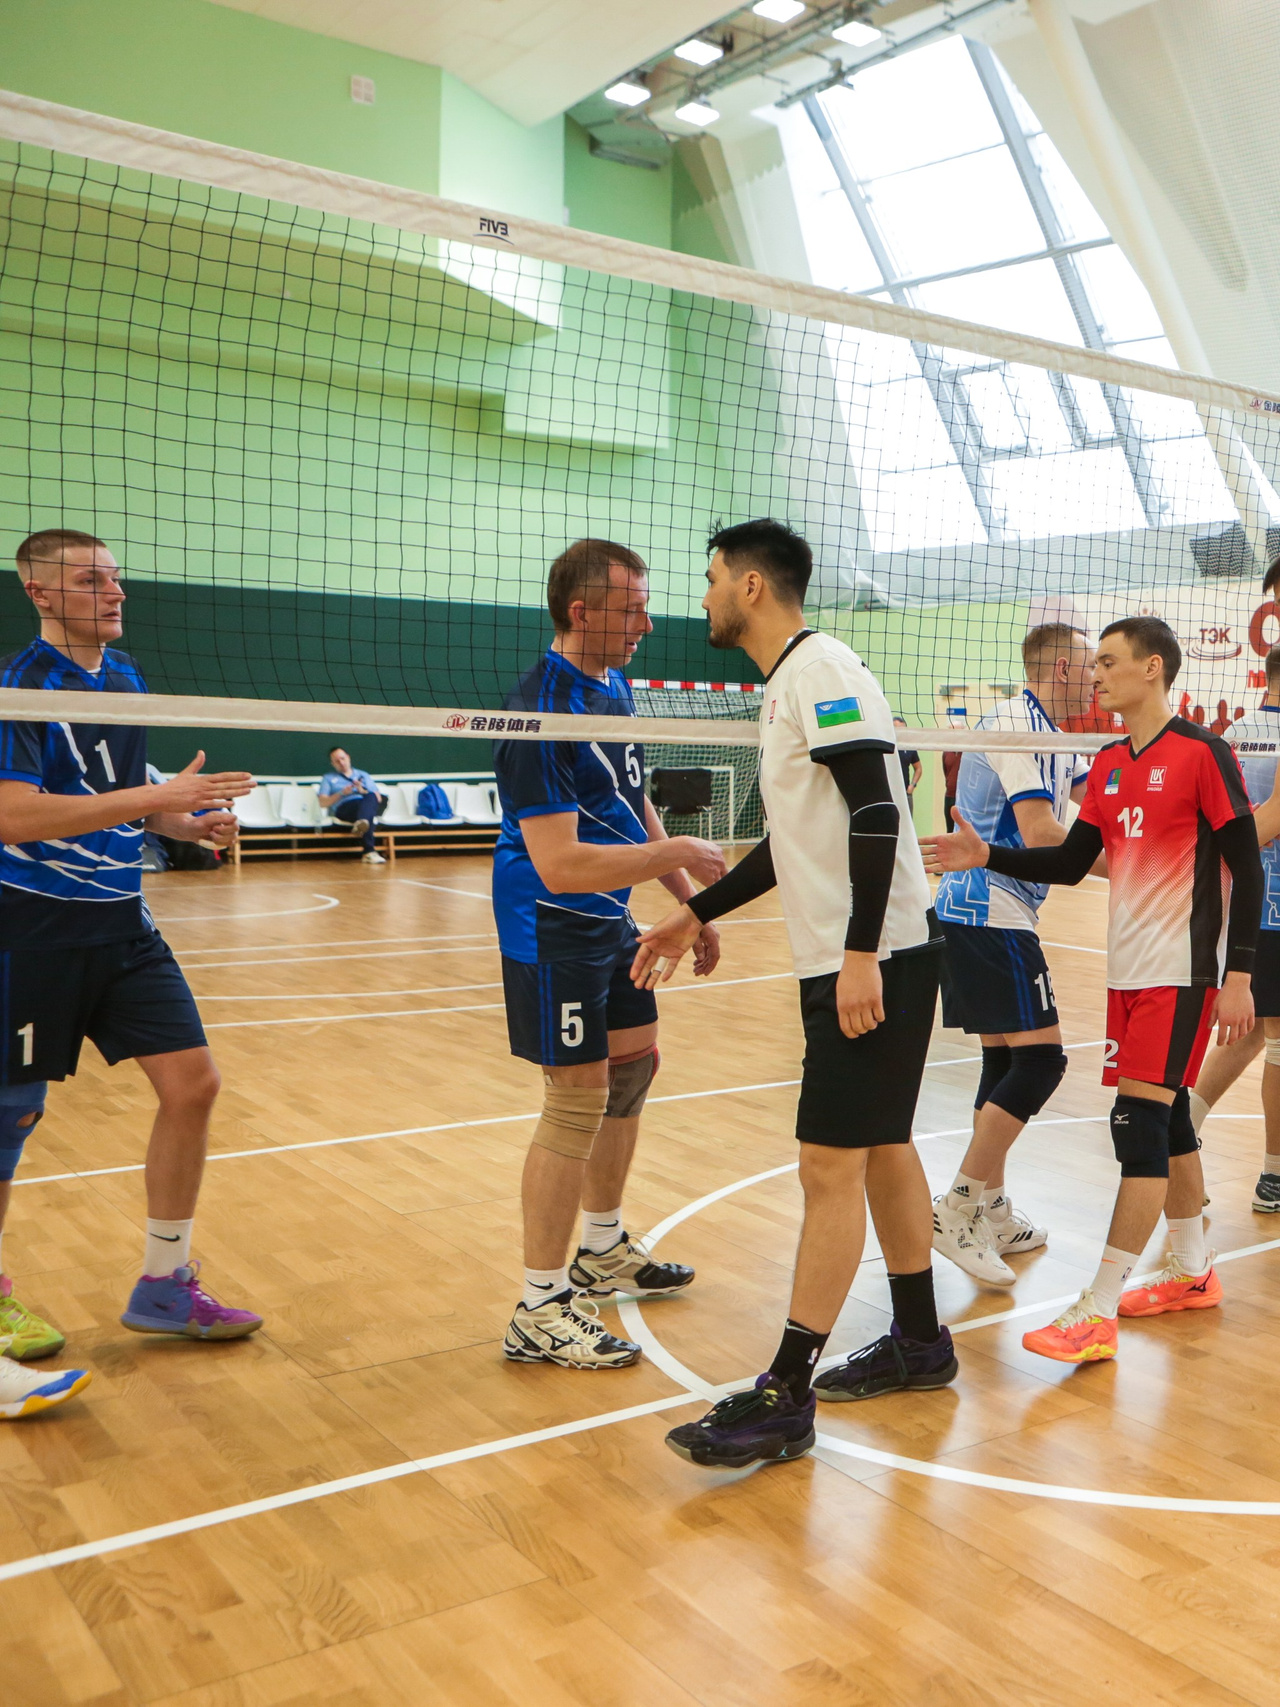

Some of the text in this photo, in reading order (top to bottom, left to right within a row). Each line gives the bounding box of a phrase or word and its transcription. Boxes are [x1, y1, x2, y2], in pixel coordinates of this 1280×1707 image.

[1199, 627, 1231, 645] ТЭК
[470, 716, 542, 733] 金陵体育
[94, 739, 117, 783] 1
[624, 742, 641, 788] 5
[1117, 806, 1144, 838] 12
[17, 1022, 34, 1066] 1
[561, 1001, 584, 1048] 5
